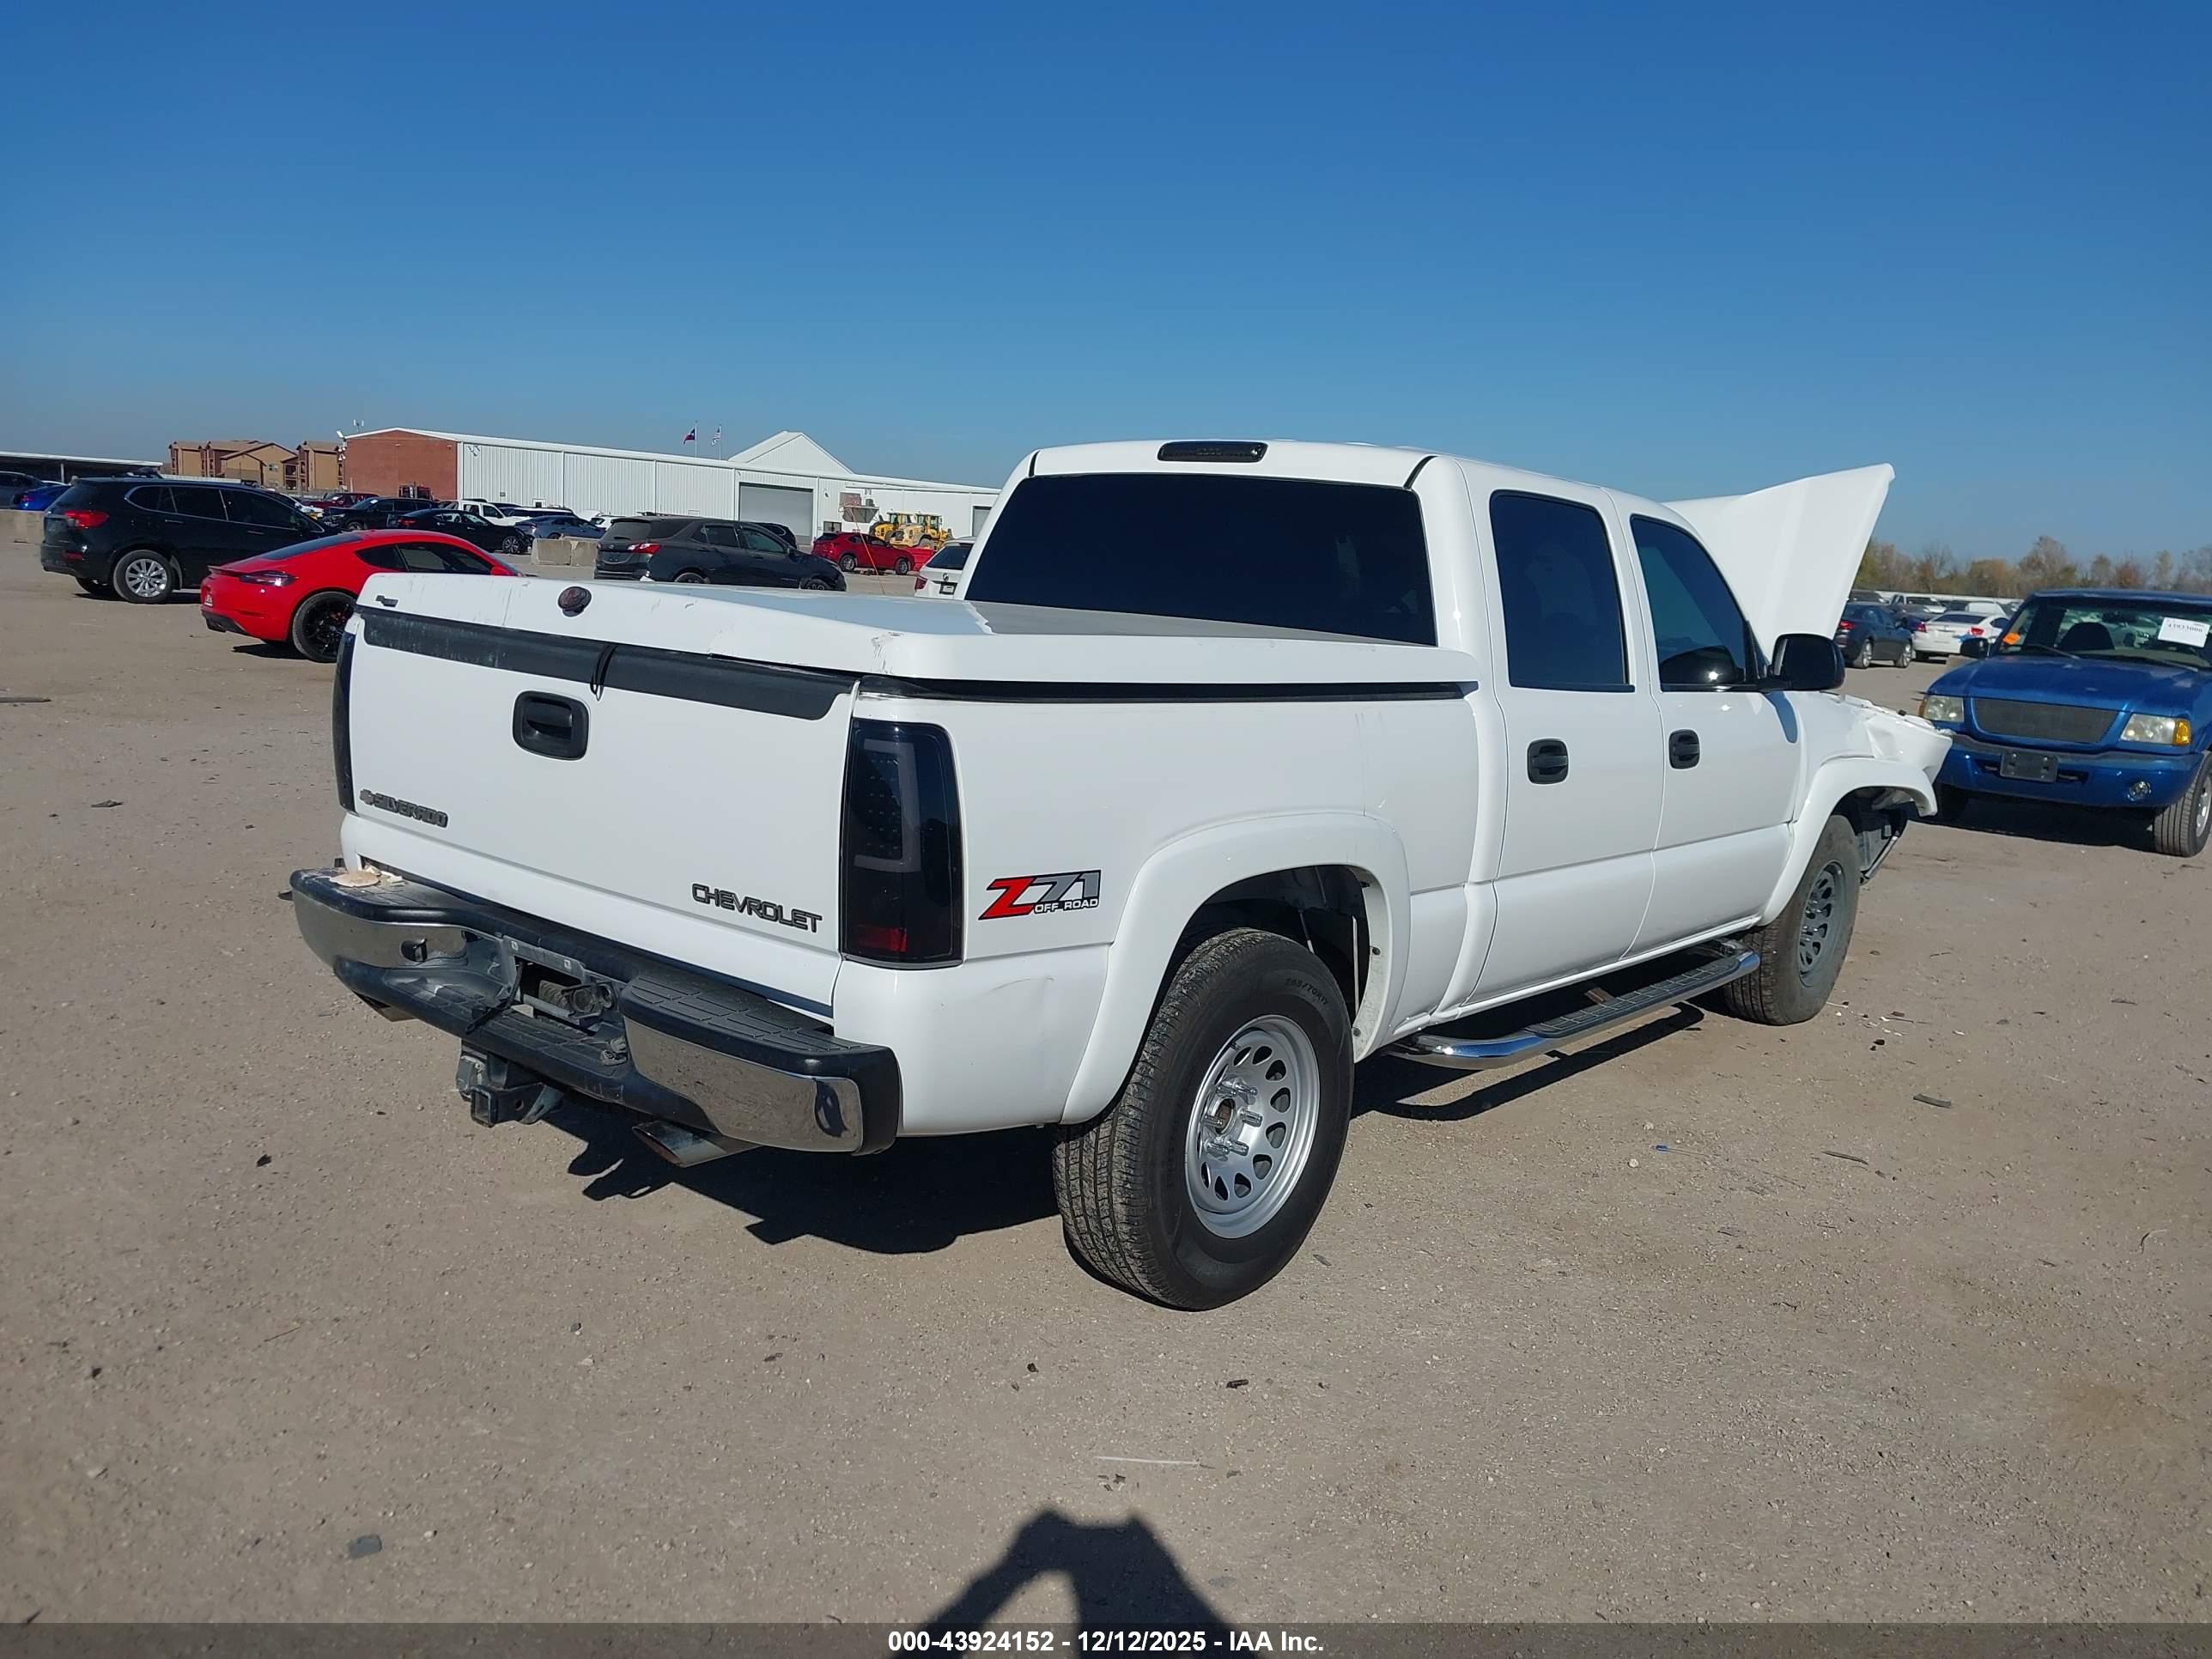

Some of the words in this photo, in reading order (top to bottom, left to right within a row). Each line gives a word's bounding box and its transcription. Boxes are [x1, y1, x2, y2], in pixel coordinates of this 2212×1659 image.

[374, 792, 449, 829] SILVERADO
[691, 883, 823, 933] CHEVROLET
[978, 869, 1102, 921] Z71
[1034, 902, 1059, 915] OFF
[1062, 897, 1099, 911] ROAD
